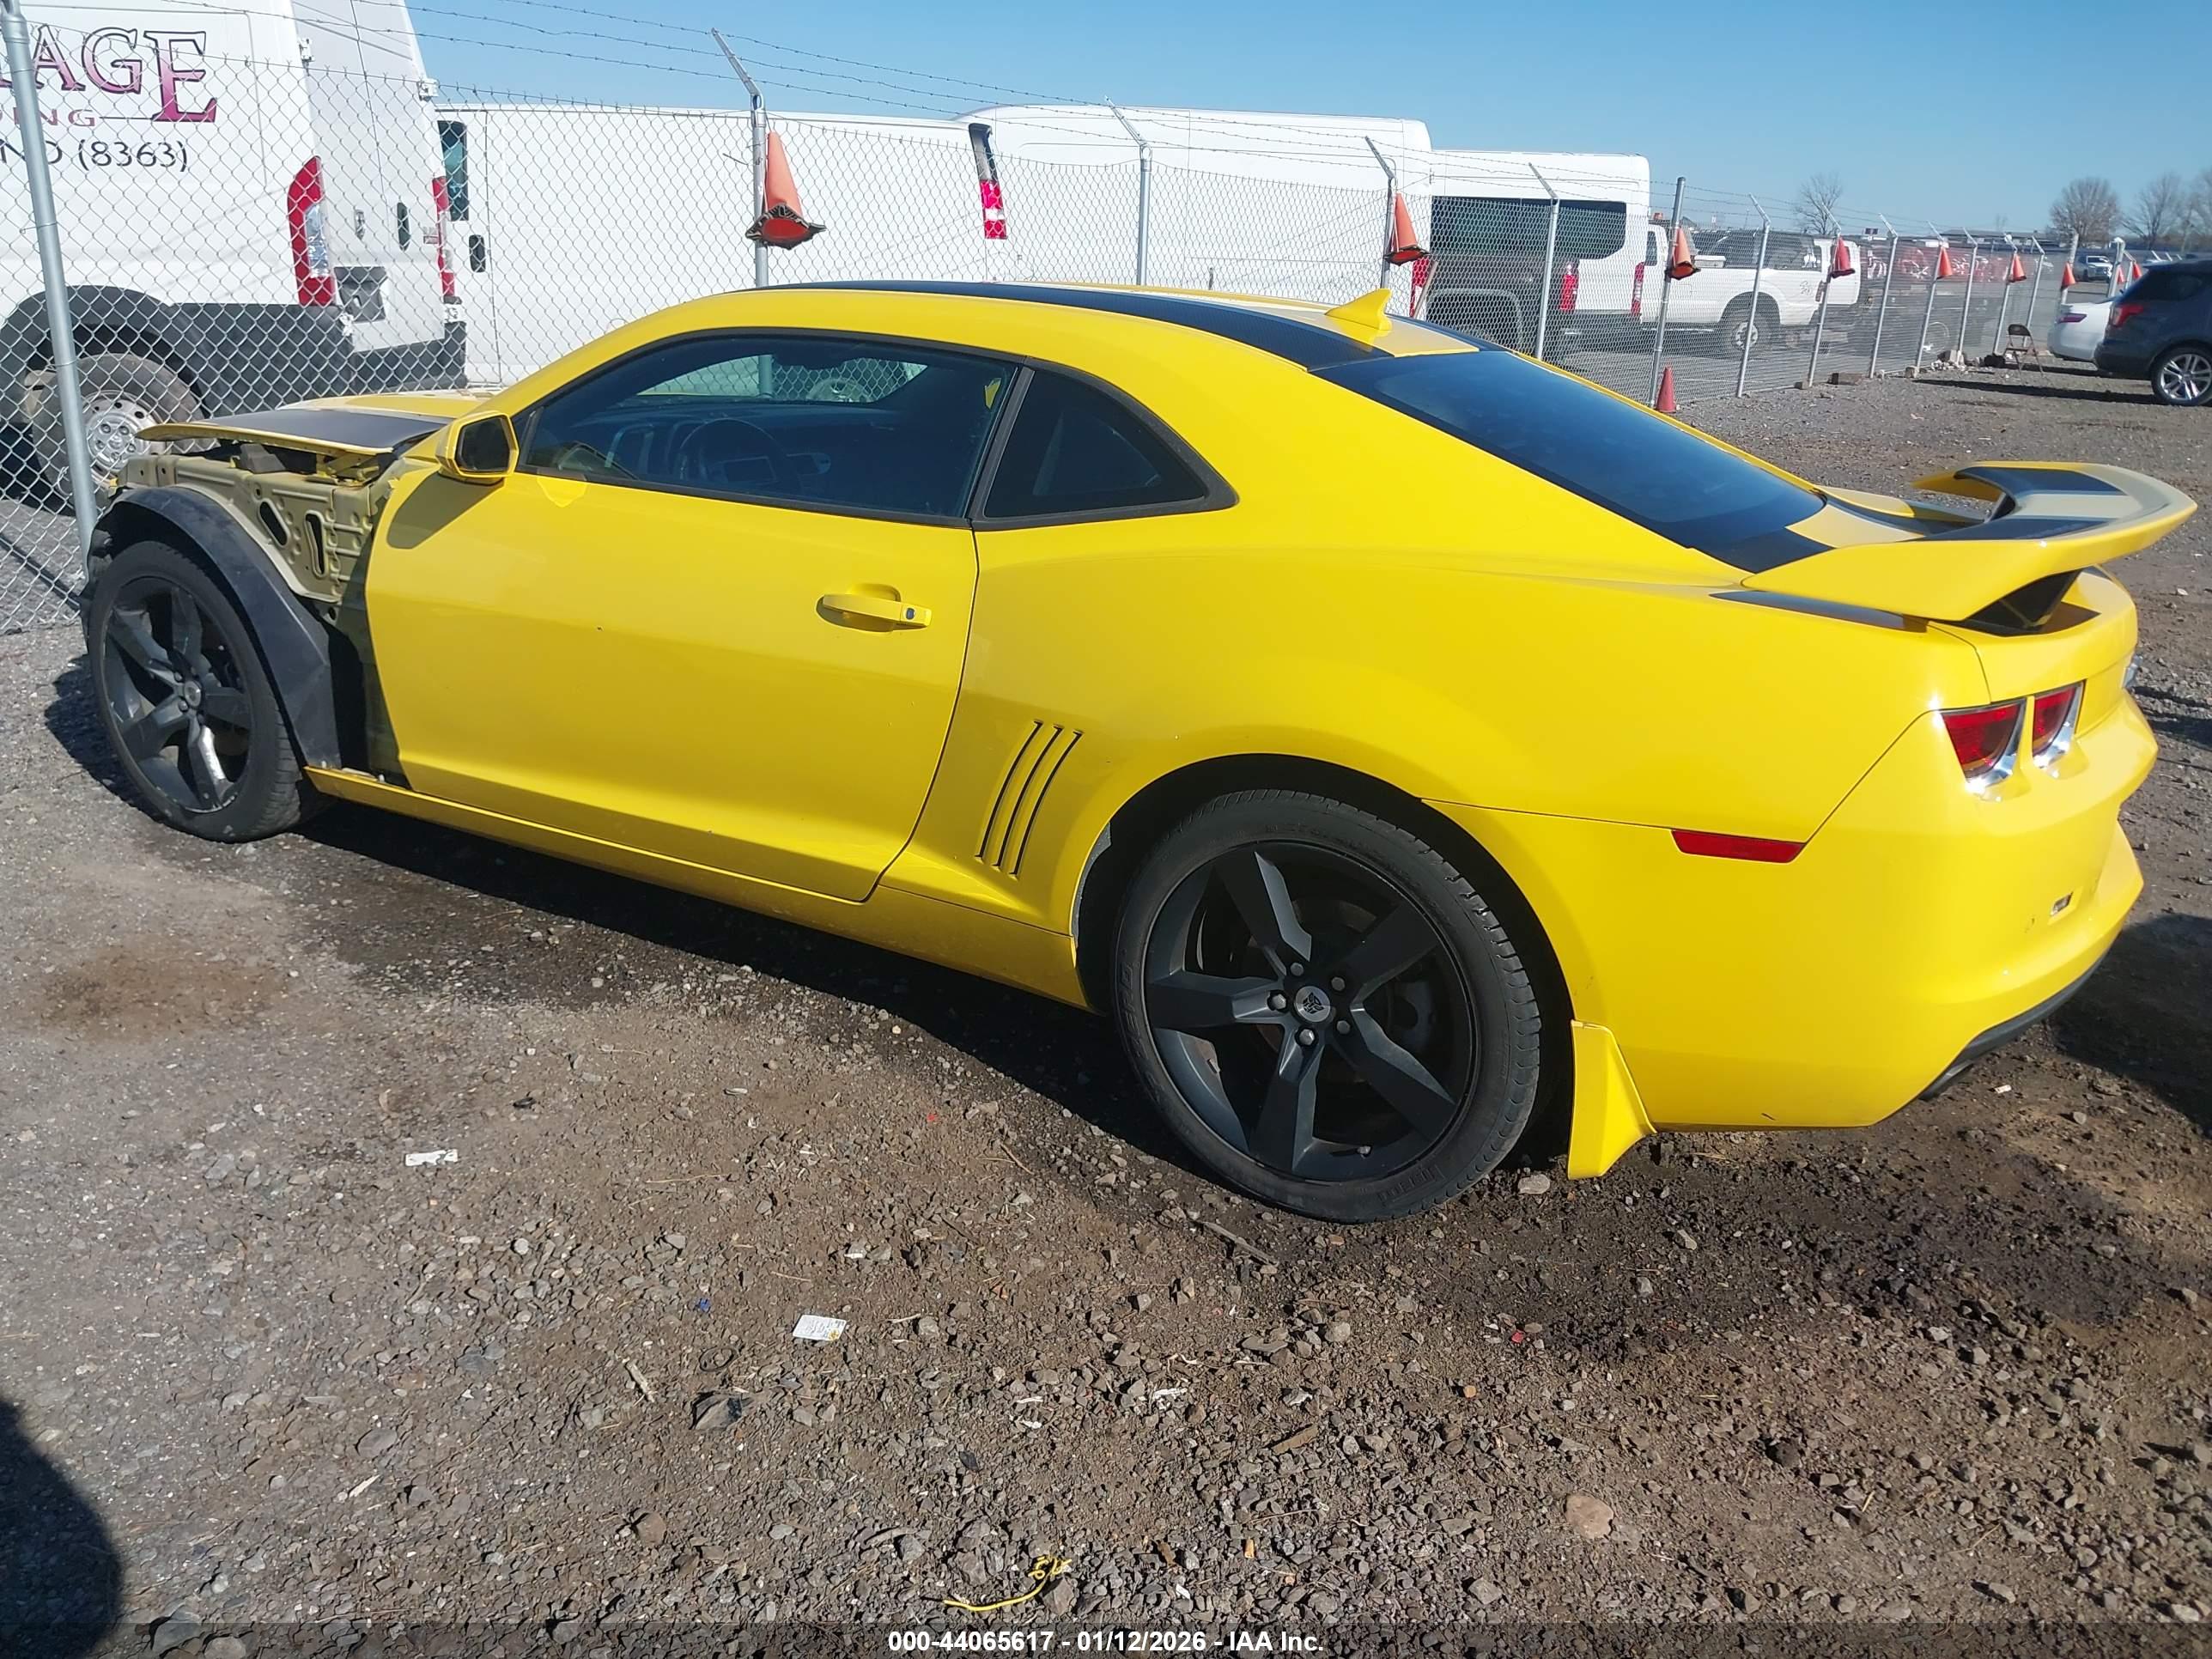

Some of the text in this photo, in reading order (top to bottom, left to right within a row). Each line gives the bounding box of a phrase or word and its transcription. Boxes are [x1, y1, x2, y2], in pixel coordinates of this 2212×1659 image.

[0, 23, 217, 123] AGE
[0, 106, 95, 127] ING
[78, 139, 187, 173] (8363)
